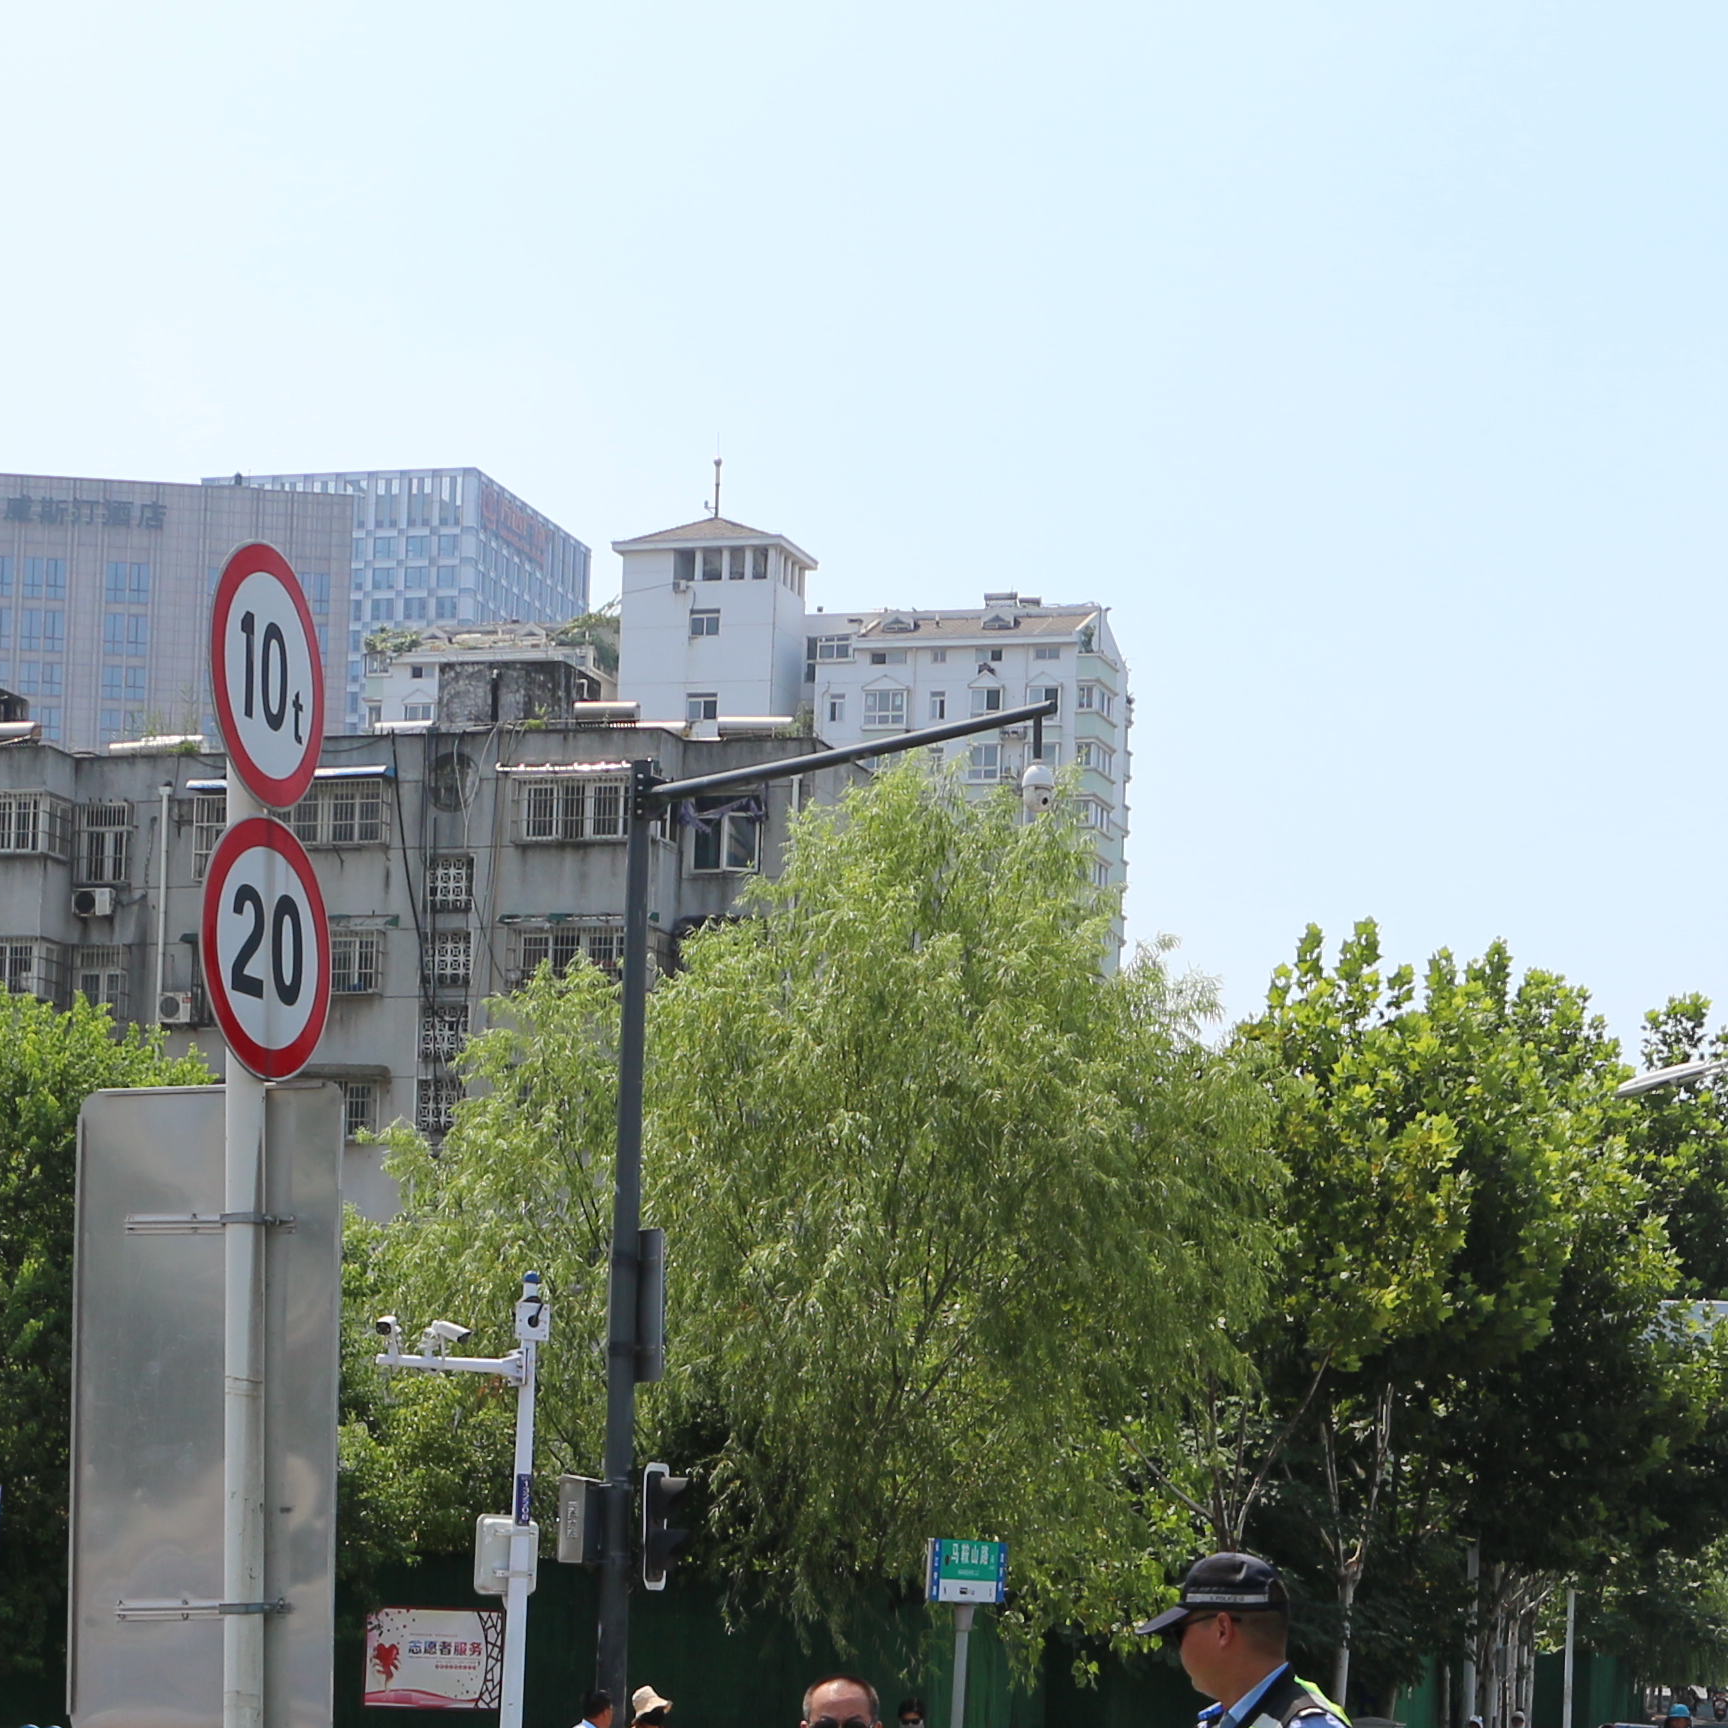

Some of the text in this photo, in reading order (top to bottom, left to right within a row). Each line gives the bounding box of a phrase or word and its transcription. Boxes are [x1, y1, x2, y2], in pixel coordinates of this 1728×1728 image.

[230, 883, 303, 1007] 20
[408, 1640, 483, 1657] 志愿者服务
